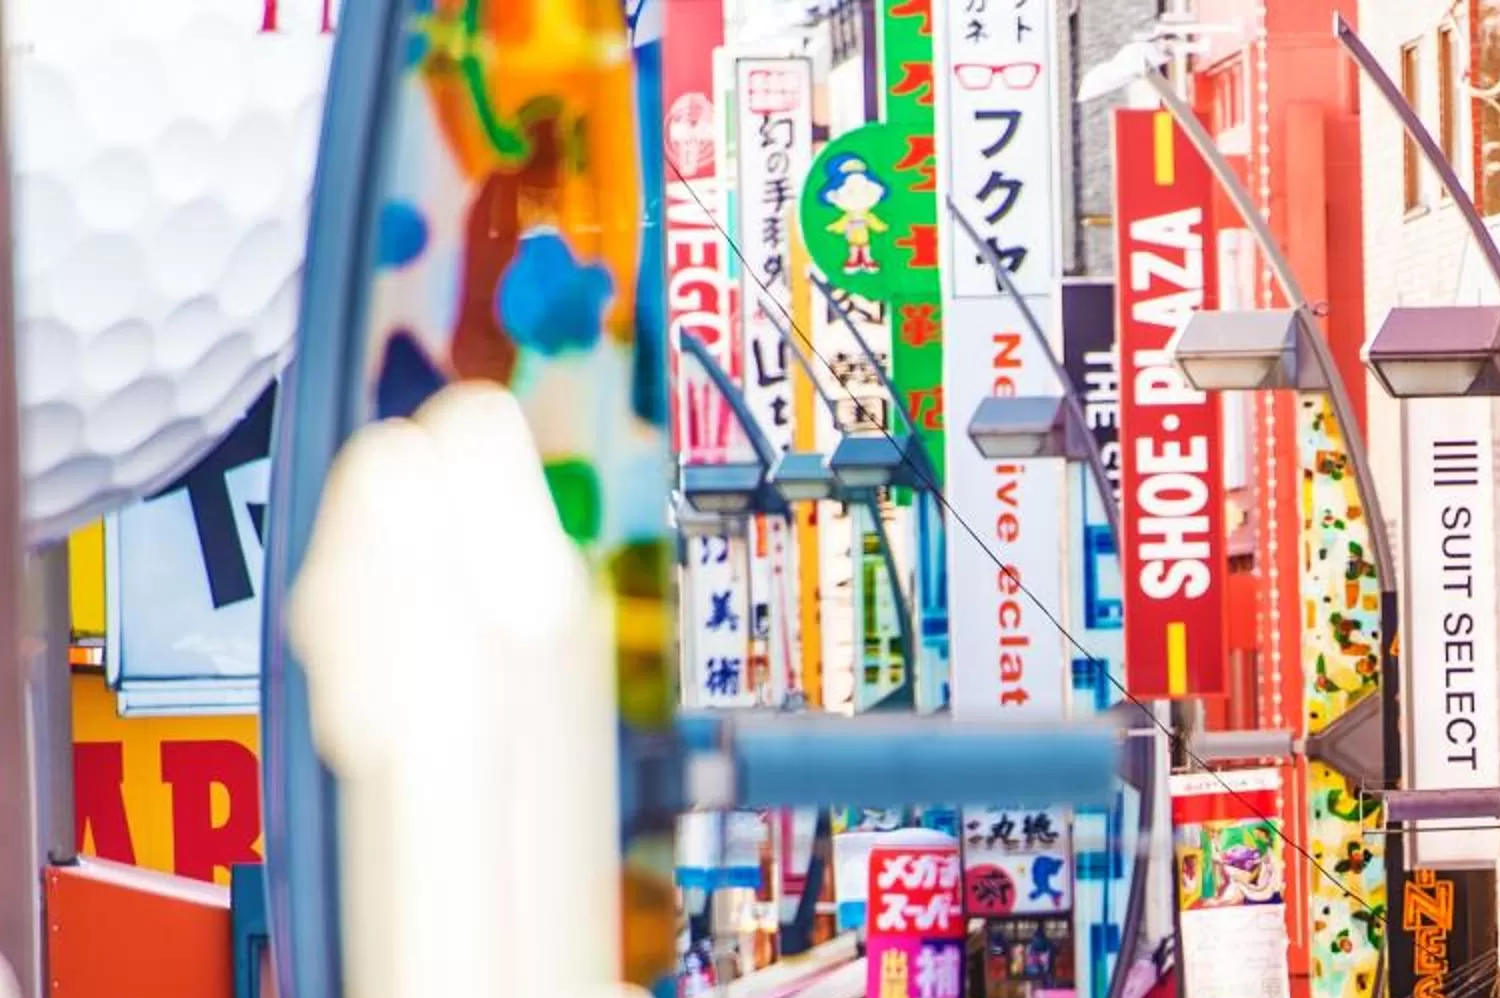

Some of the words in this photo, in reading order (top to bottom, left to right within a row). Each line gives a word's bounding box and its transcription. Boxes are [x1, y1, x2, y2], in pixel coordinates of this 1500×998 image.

[976, 110, 1028, 292] フクヤ
[1441, 506, 1473, 599] SUIT
[995, 564, 1031, 706] eclat
[1443, 613, 1478, 771] SELECT
